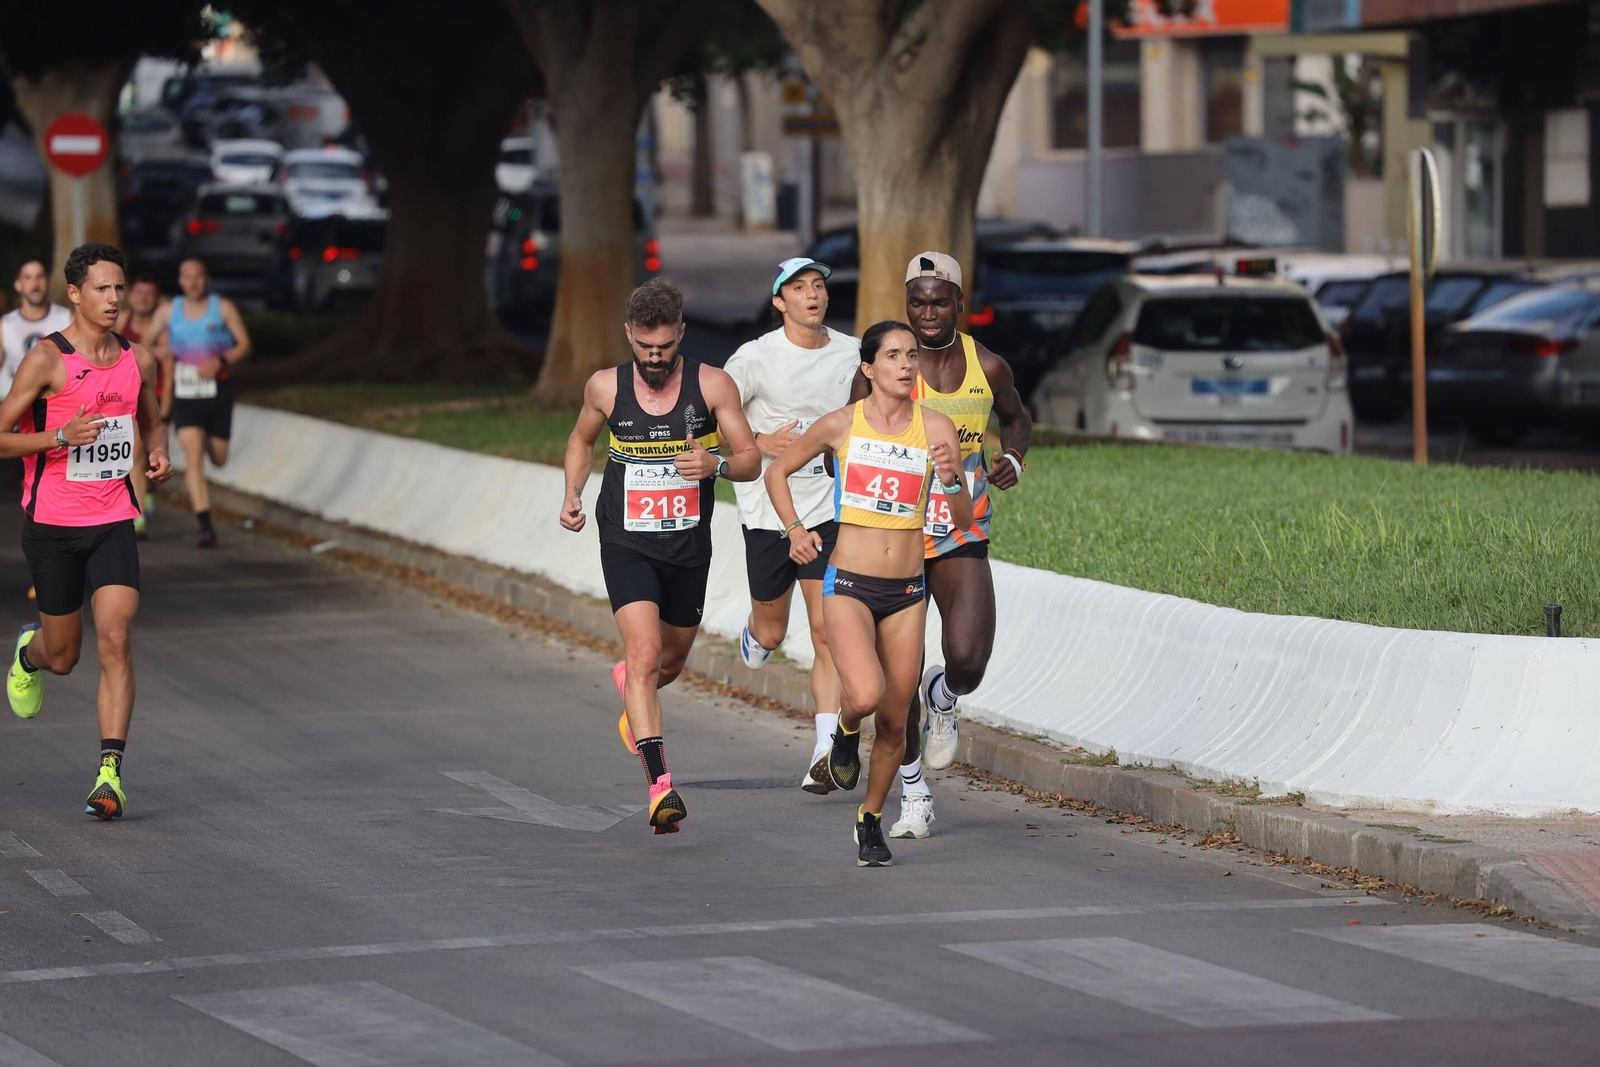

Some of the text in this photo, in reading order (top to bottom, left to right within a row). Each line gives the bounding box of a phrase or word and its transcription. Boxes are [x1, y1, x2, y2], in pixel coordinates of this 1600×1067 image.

[969, 385, 984, 395] vive
[649, 430, 670, 440] gross
[72, 441, 131, 464] 11950
[634, 443, 675, 455] TRIATLÓN
[861, 443, 885, 454] 45
[635, 468, 658, 478] 45
[866, 474, 900, 501] 43
[640, 495, 687, 519] 218
[926, 499, 952, 524] 45
